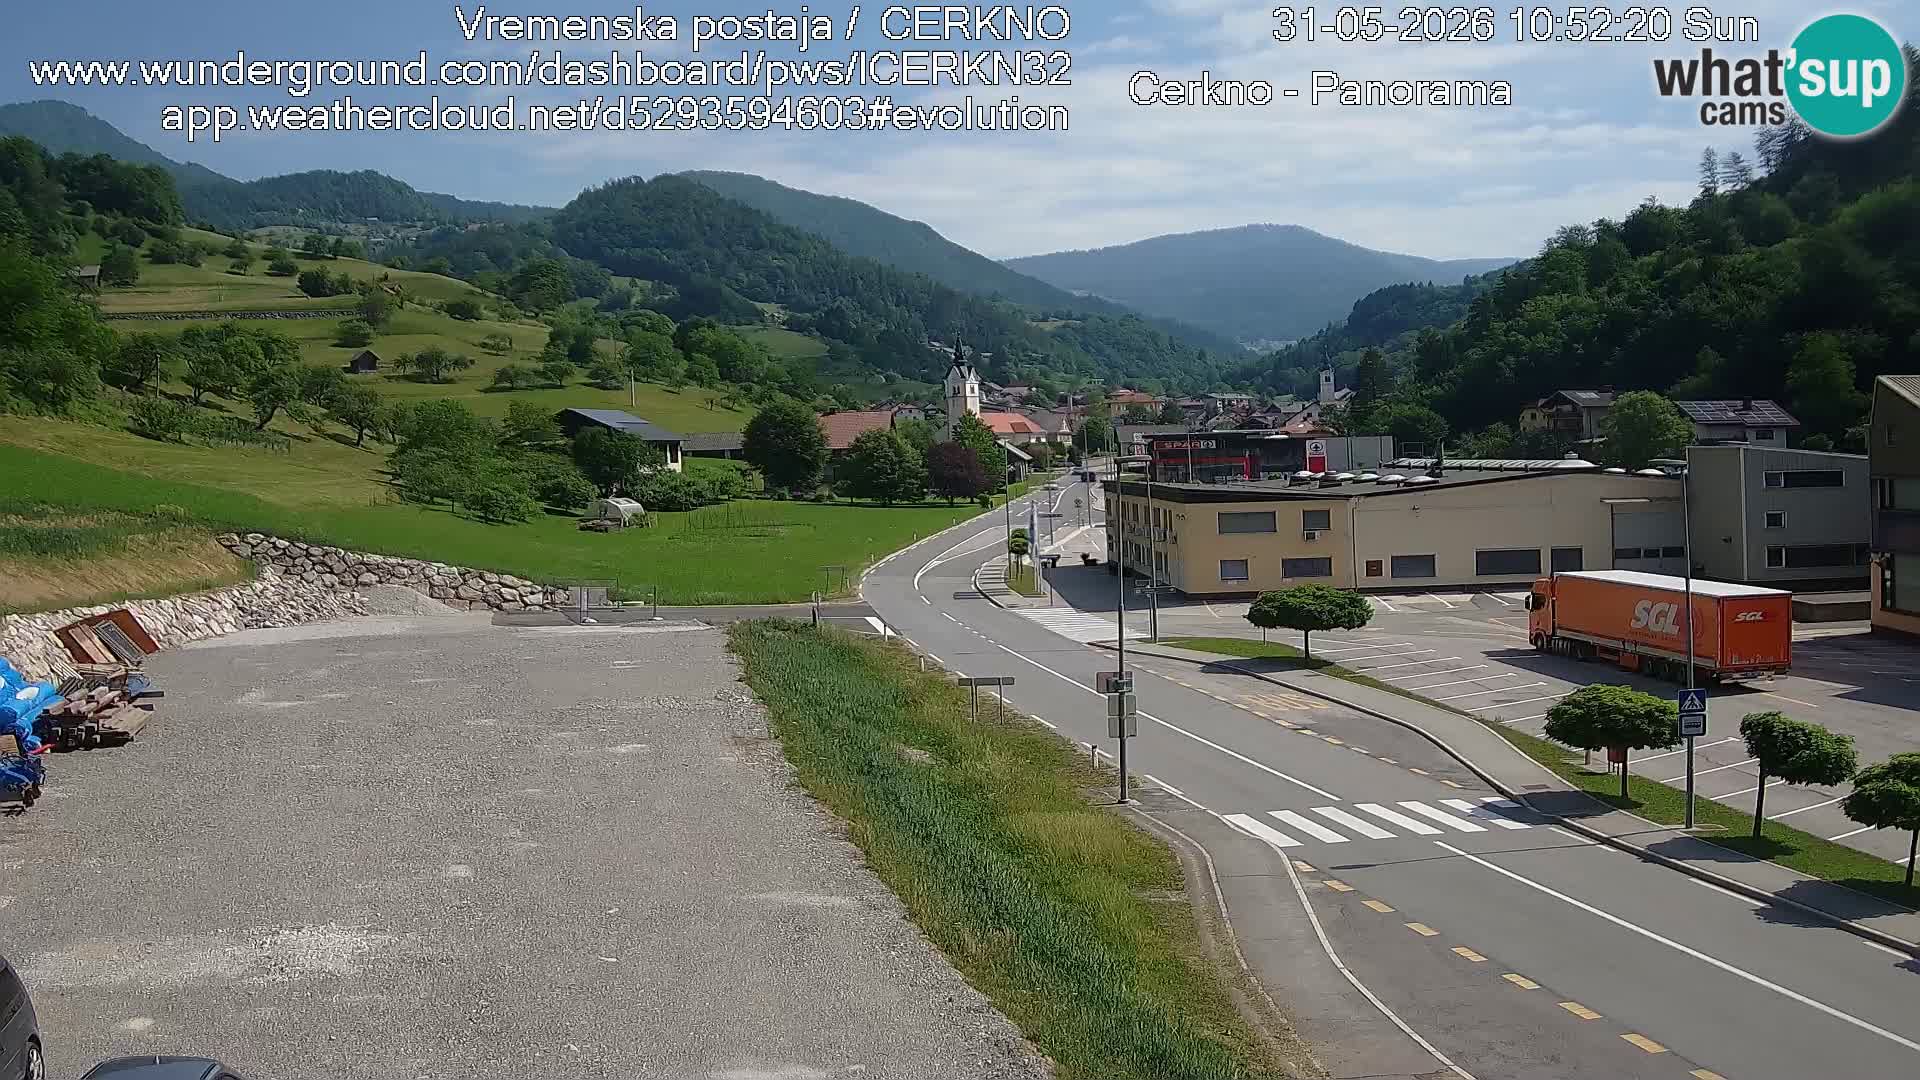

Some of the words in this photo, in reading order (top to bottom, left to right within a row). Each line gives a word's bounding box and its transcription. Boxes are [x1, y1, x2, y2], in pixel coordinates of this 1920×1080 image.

[1164, 441, 1200, 449] SPAR
[1630, 599, 1680, 635] SGL
[1734, 611, 1764, 622] SGL
